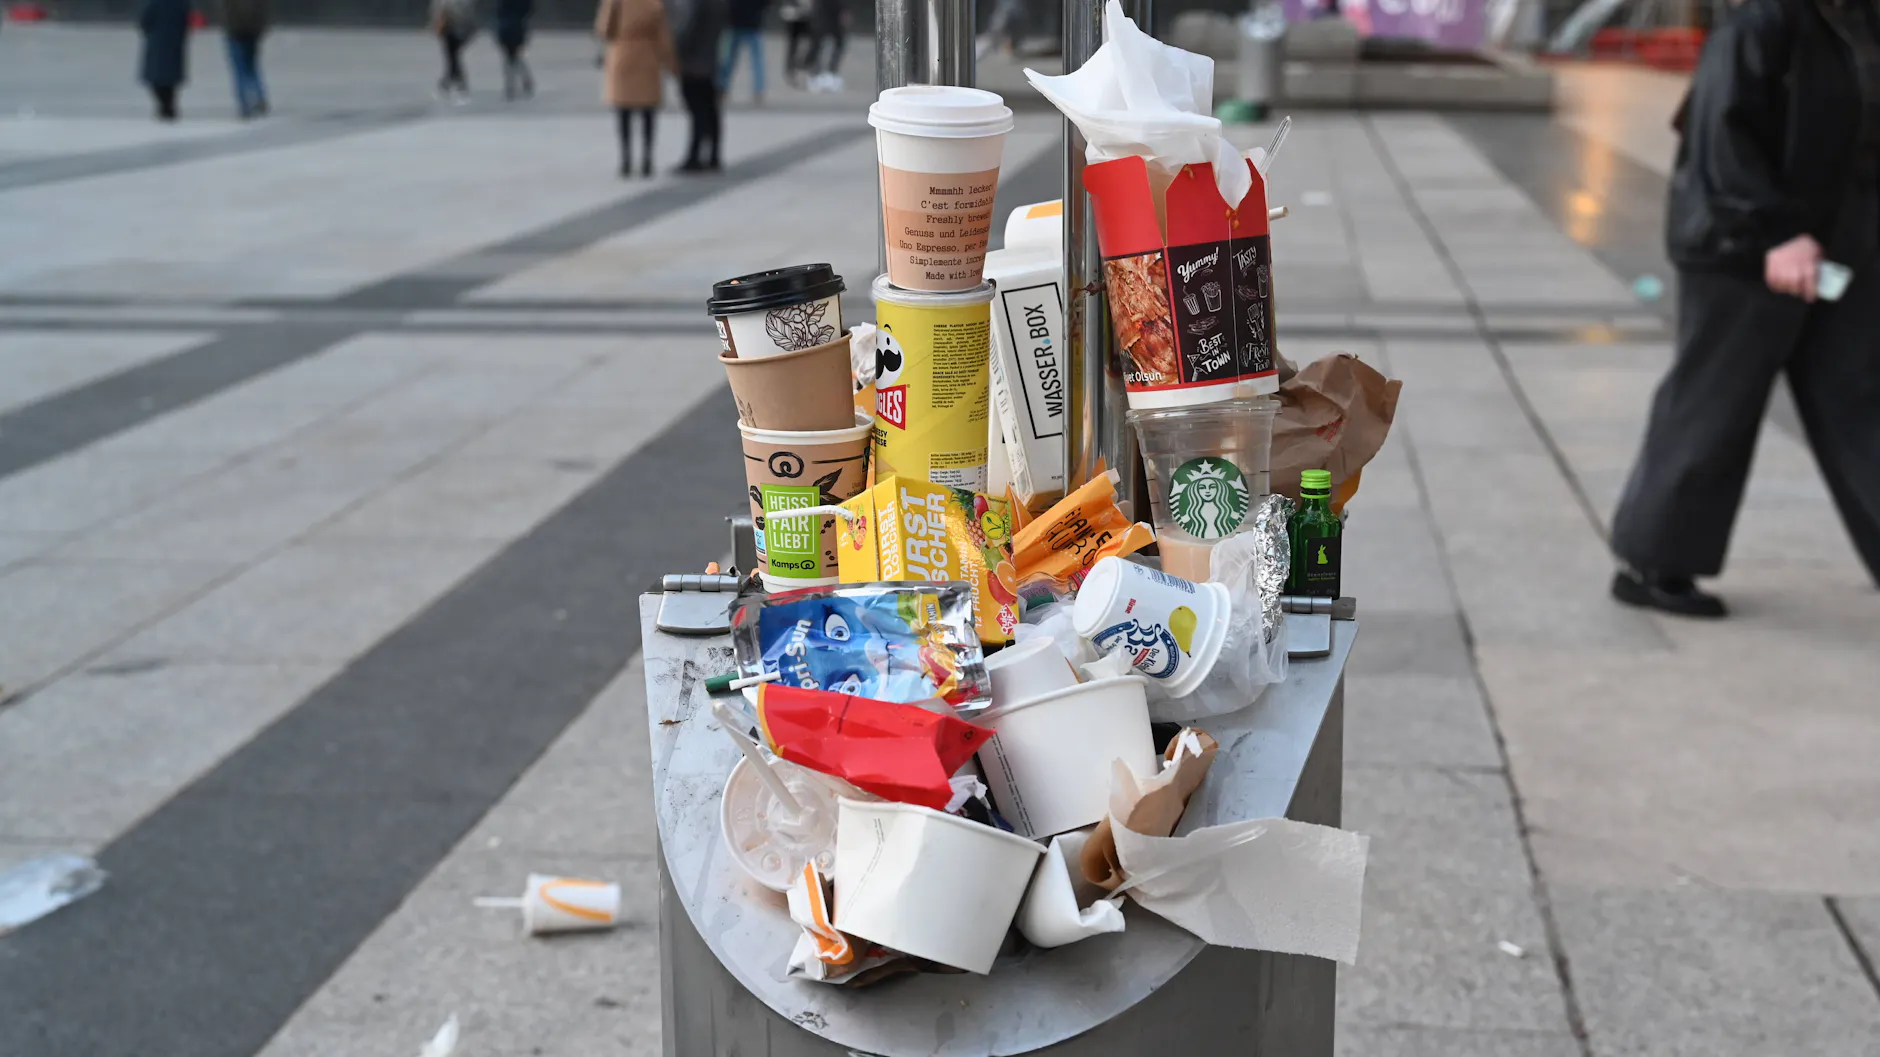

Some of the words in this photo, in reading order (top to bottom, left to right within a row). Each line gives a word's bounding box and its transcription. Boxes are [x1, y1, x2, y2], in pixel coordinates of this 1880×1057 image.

[921, 200, 949, 210] C'est
[926, 215, 964, 225] Freshly
[905, 227, 935, 238] Genuss
[900, 240, 913, 250] Uno
[964, 244, 977, 253] per
[910, 256, 962, 267] Simplemente
[1177, 247, 1219, 283] Yummy!
[926, 271, 946, 280] Made
[949, 271, 967, 280] with
[1135, 372, 1162, 382] Olsun
[769, 495, 809, 510] HEISS
[772, 514, 810, 532] FAIR
[773, 533, 810, 549] LIEBT
[880, 509, 894, 581] DURST
[771, 558, 800, 570] Kamps
[975, 616, 982, 628] 12
